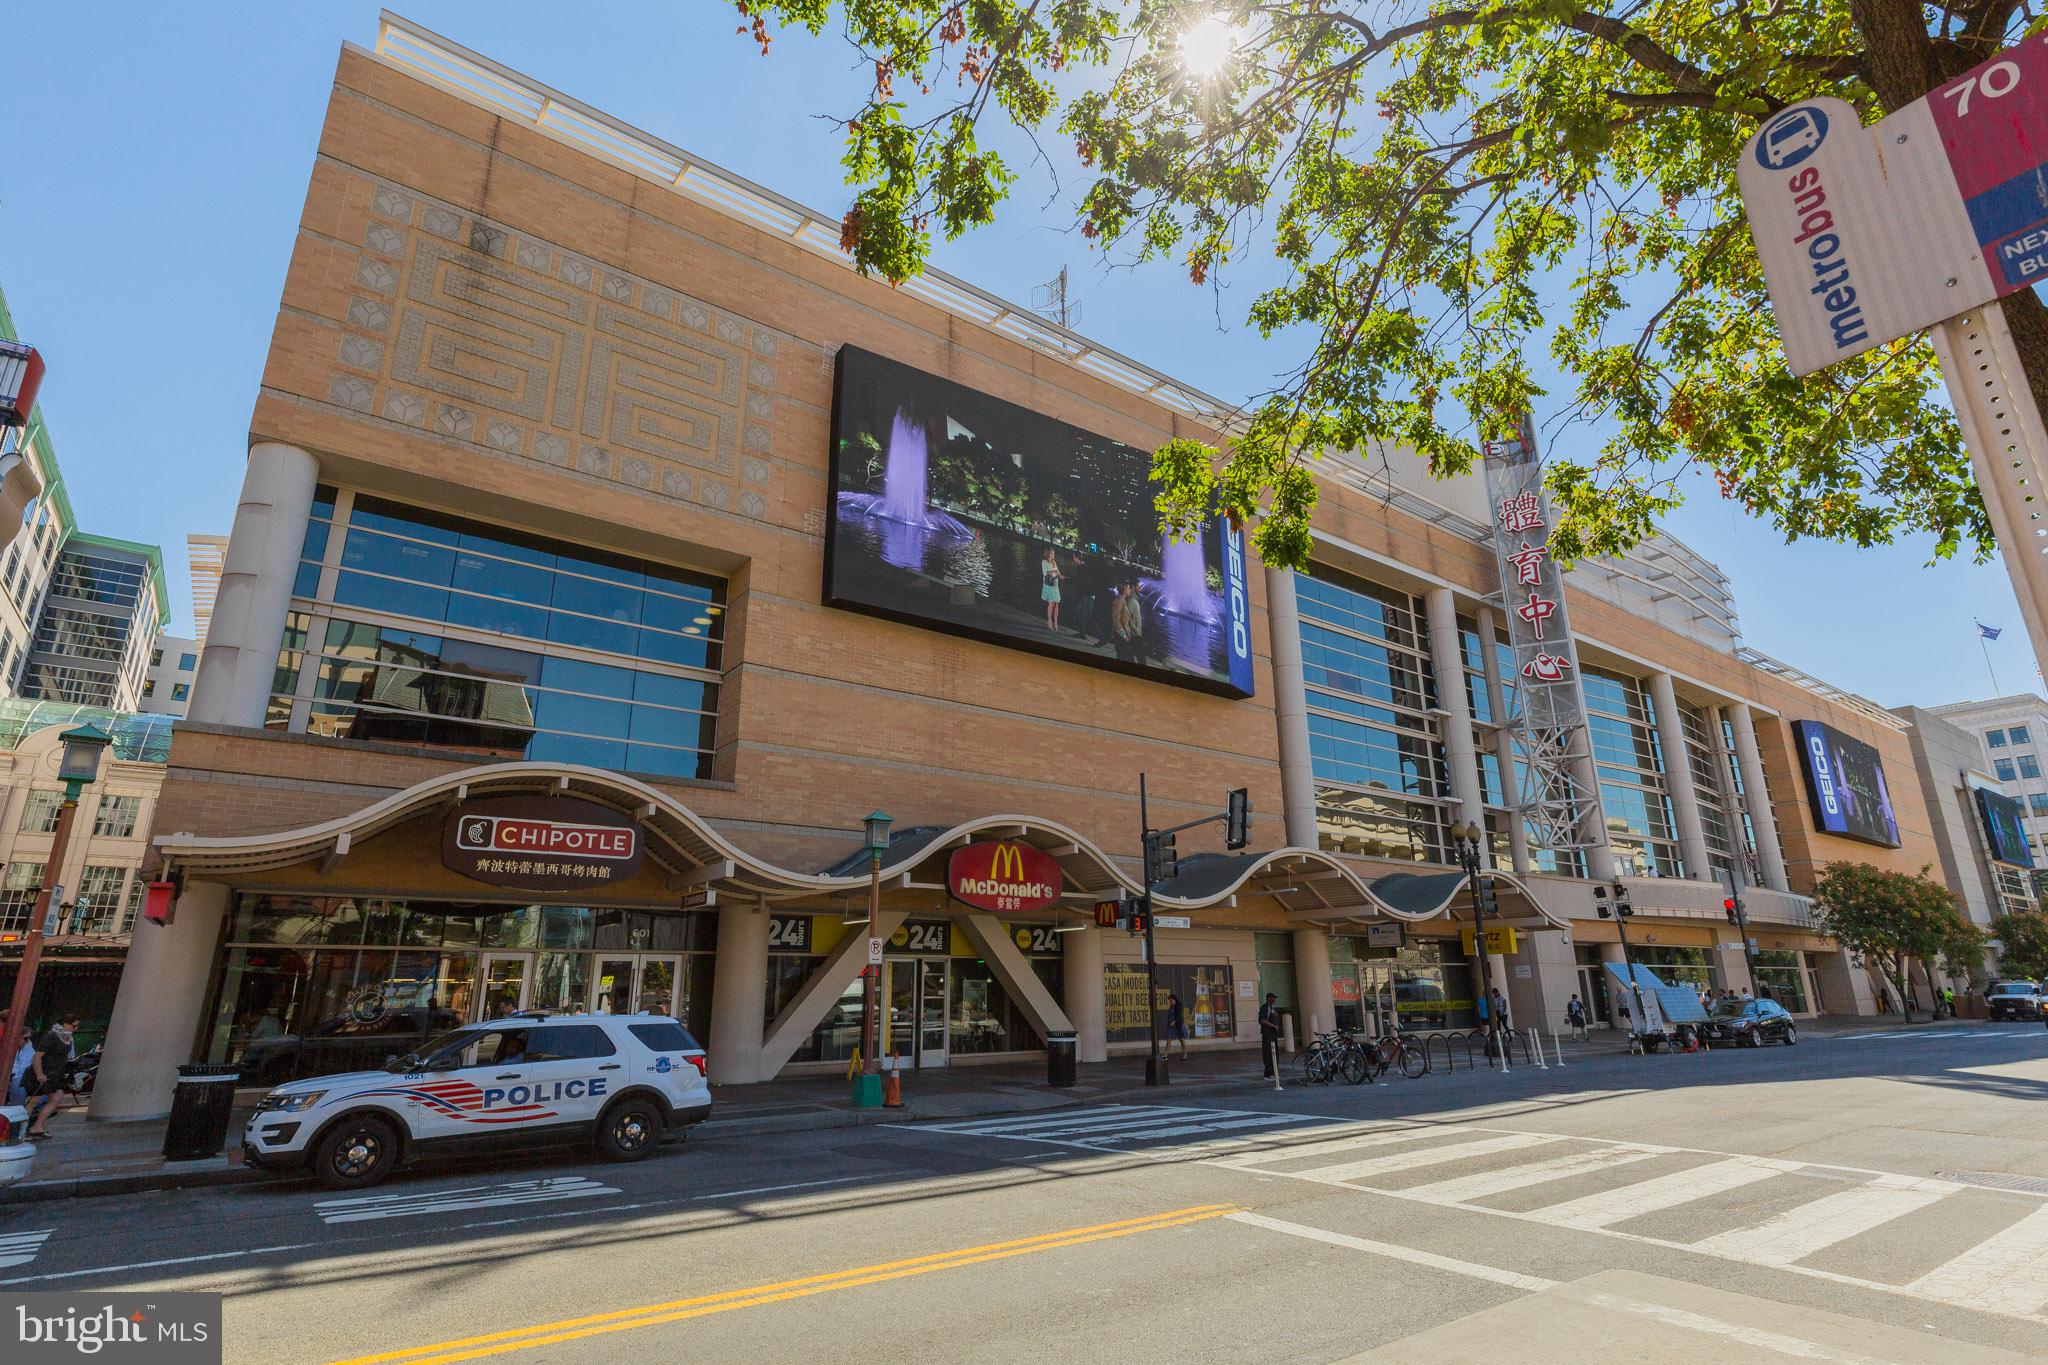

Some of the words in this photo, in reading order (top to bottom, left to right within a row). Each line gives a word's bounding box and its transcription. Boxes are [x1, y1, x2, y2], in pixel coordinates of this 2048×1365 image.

[1943, 61, 2021, 118] 70
[1788, 165, 1869, 349] metrobus
[1810, 736, 1838, 815] GEICO
[501, 826, 627, 851] CHIPOTLE
[959, 878, 1053, 898] McDonald's
[632, 928, 650, 938] 601
[769, 919, 798, 946] 24
[797, 919, 805, 946] hours
[909, 925, 938, 950] 24
[936, 926, 944, 950] hours
[1032, 928, 1057, 951] 24
[1472, 931, 1500, 941] Hrtz
[1135, 993, 1149, 1006] BEE
[483, 1077, 607, 1108] POLICE
